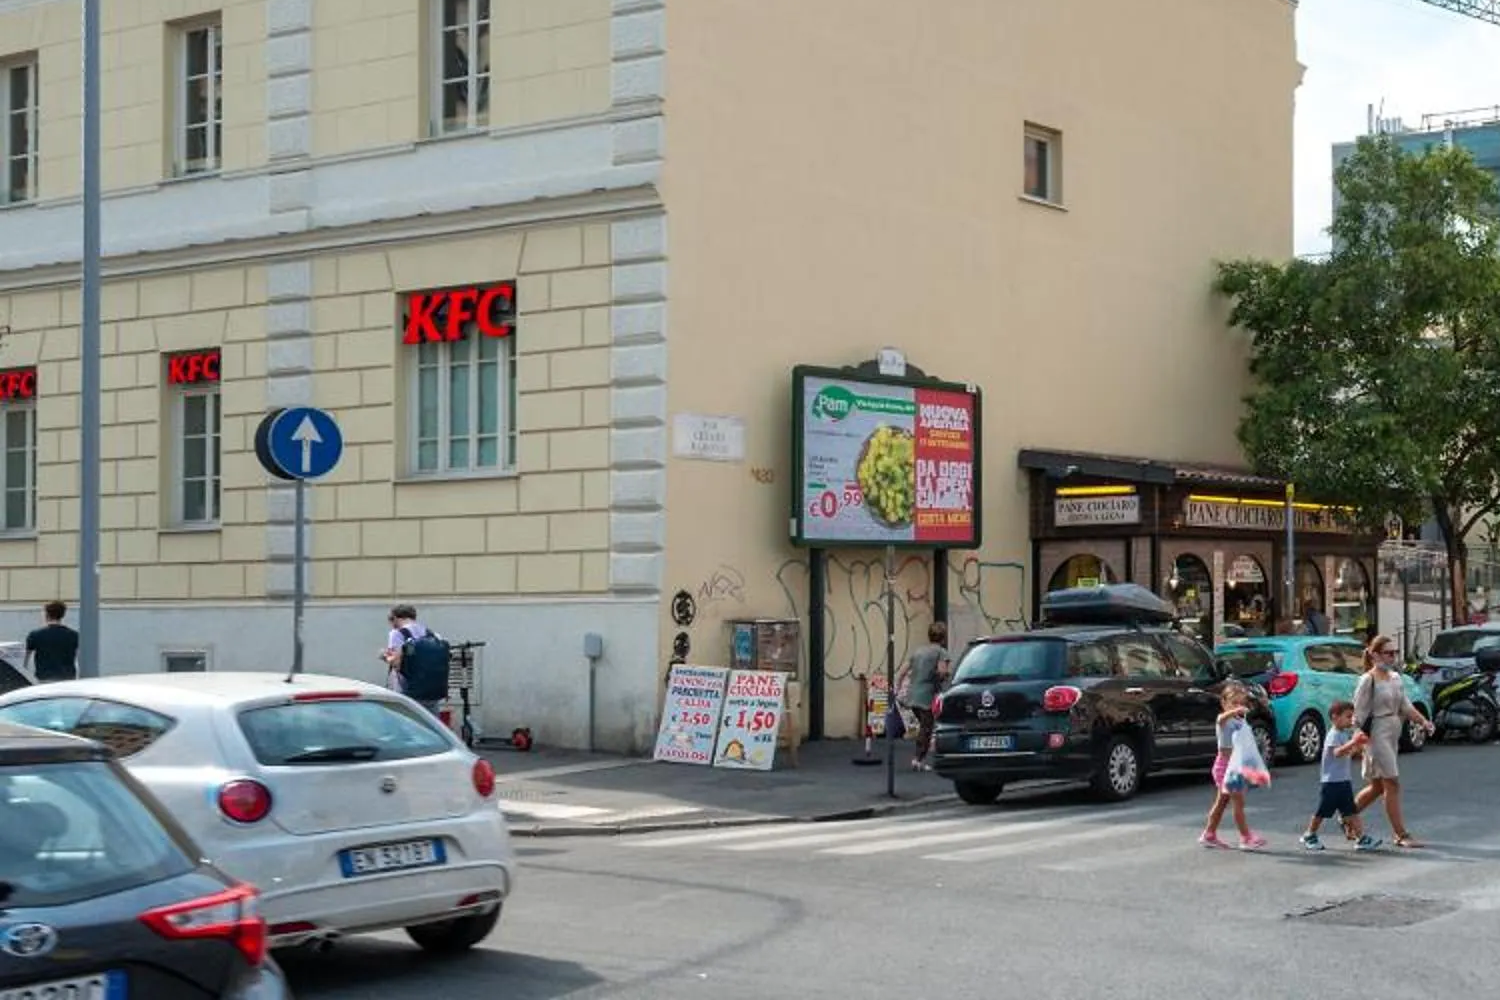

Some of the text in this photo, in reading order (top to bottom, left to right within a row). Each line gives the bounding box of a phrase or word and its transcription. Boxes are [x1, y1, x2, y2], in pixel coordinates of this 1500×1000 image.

[403, 284, 513, 344] KFC
[168, 352, 219, 386] KFC
[818, 396, 849, 413] Pam
[919, 403, 968, 420] NUOVA
[1058, 502, 1085, 513] PANE
[1188, 503, 1221, 522] PANE
[736, 675, 779, 686] PANE
[729, 685, 781, 697] CIOCIARO
[736, 710, 776, 731] 1,50
